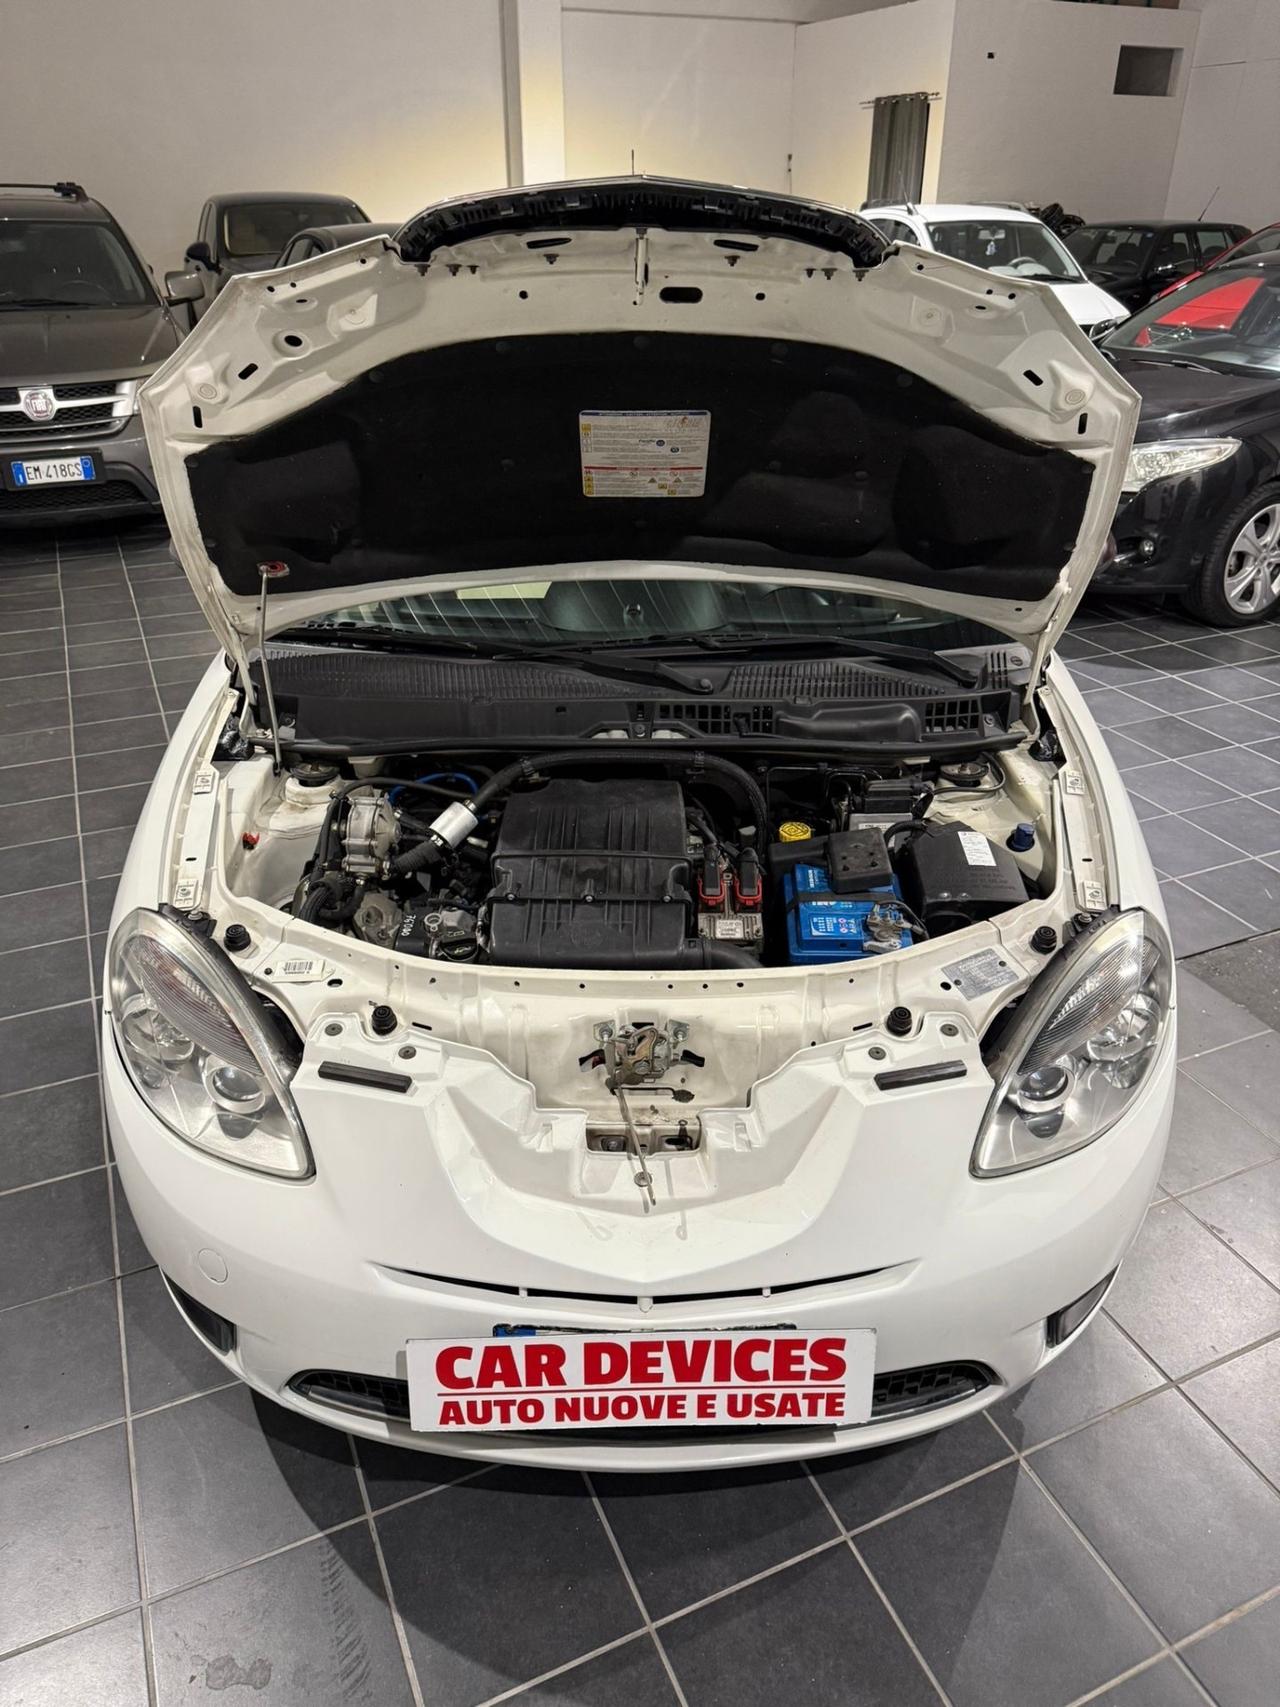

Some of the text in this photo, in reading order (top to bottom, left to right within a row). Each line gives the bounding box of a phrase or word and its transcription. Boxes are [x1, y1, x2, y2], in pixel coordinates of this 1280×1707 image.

[26, 466, 42, 480] EM
[436, 1338, 847, 1390] CAR DEVICES
[439, 1393, 845, 1425] AUTO NUOVE E USATE
